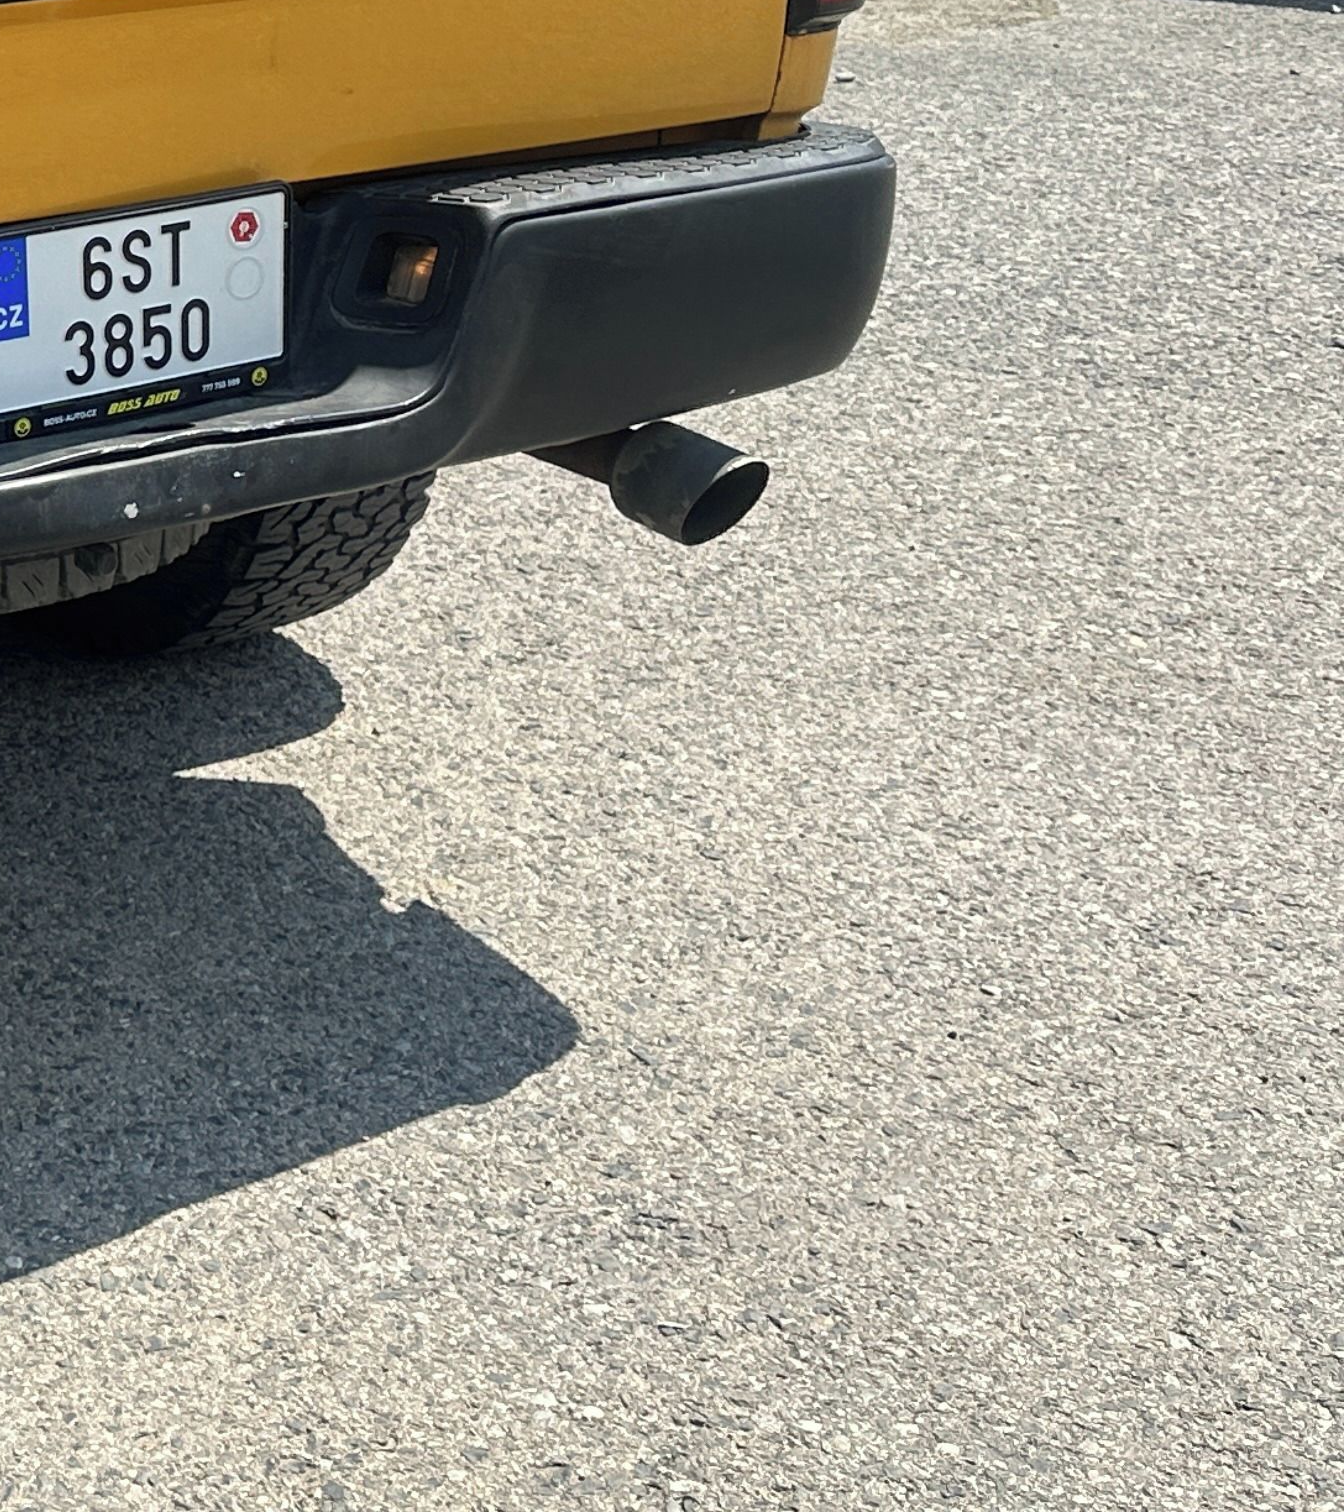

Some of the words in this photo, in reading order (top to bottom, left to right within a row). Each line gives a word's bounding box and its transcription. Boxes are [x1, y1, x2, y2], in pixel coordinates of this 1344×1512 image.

[82, 220, 191, 300] 6ST
[64, 298, 210, 385] 3850
[107, 397, 143, 415] BOSS
[143, 388, 181, 408] AUTO
